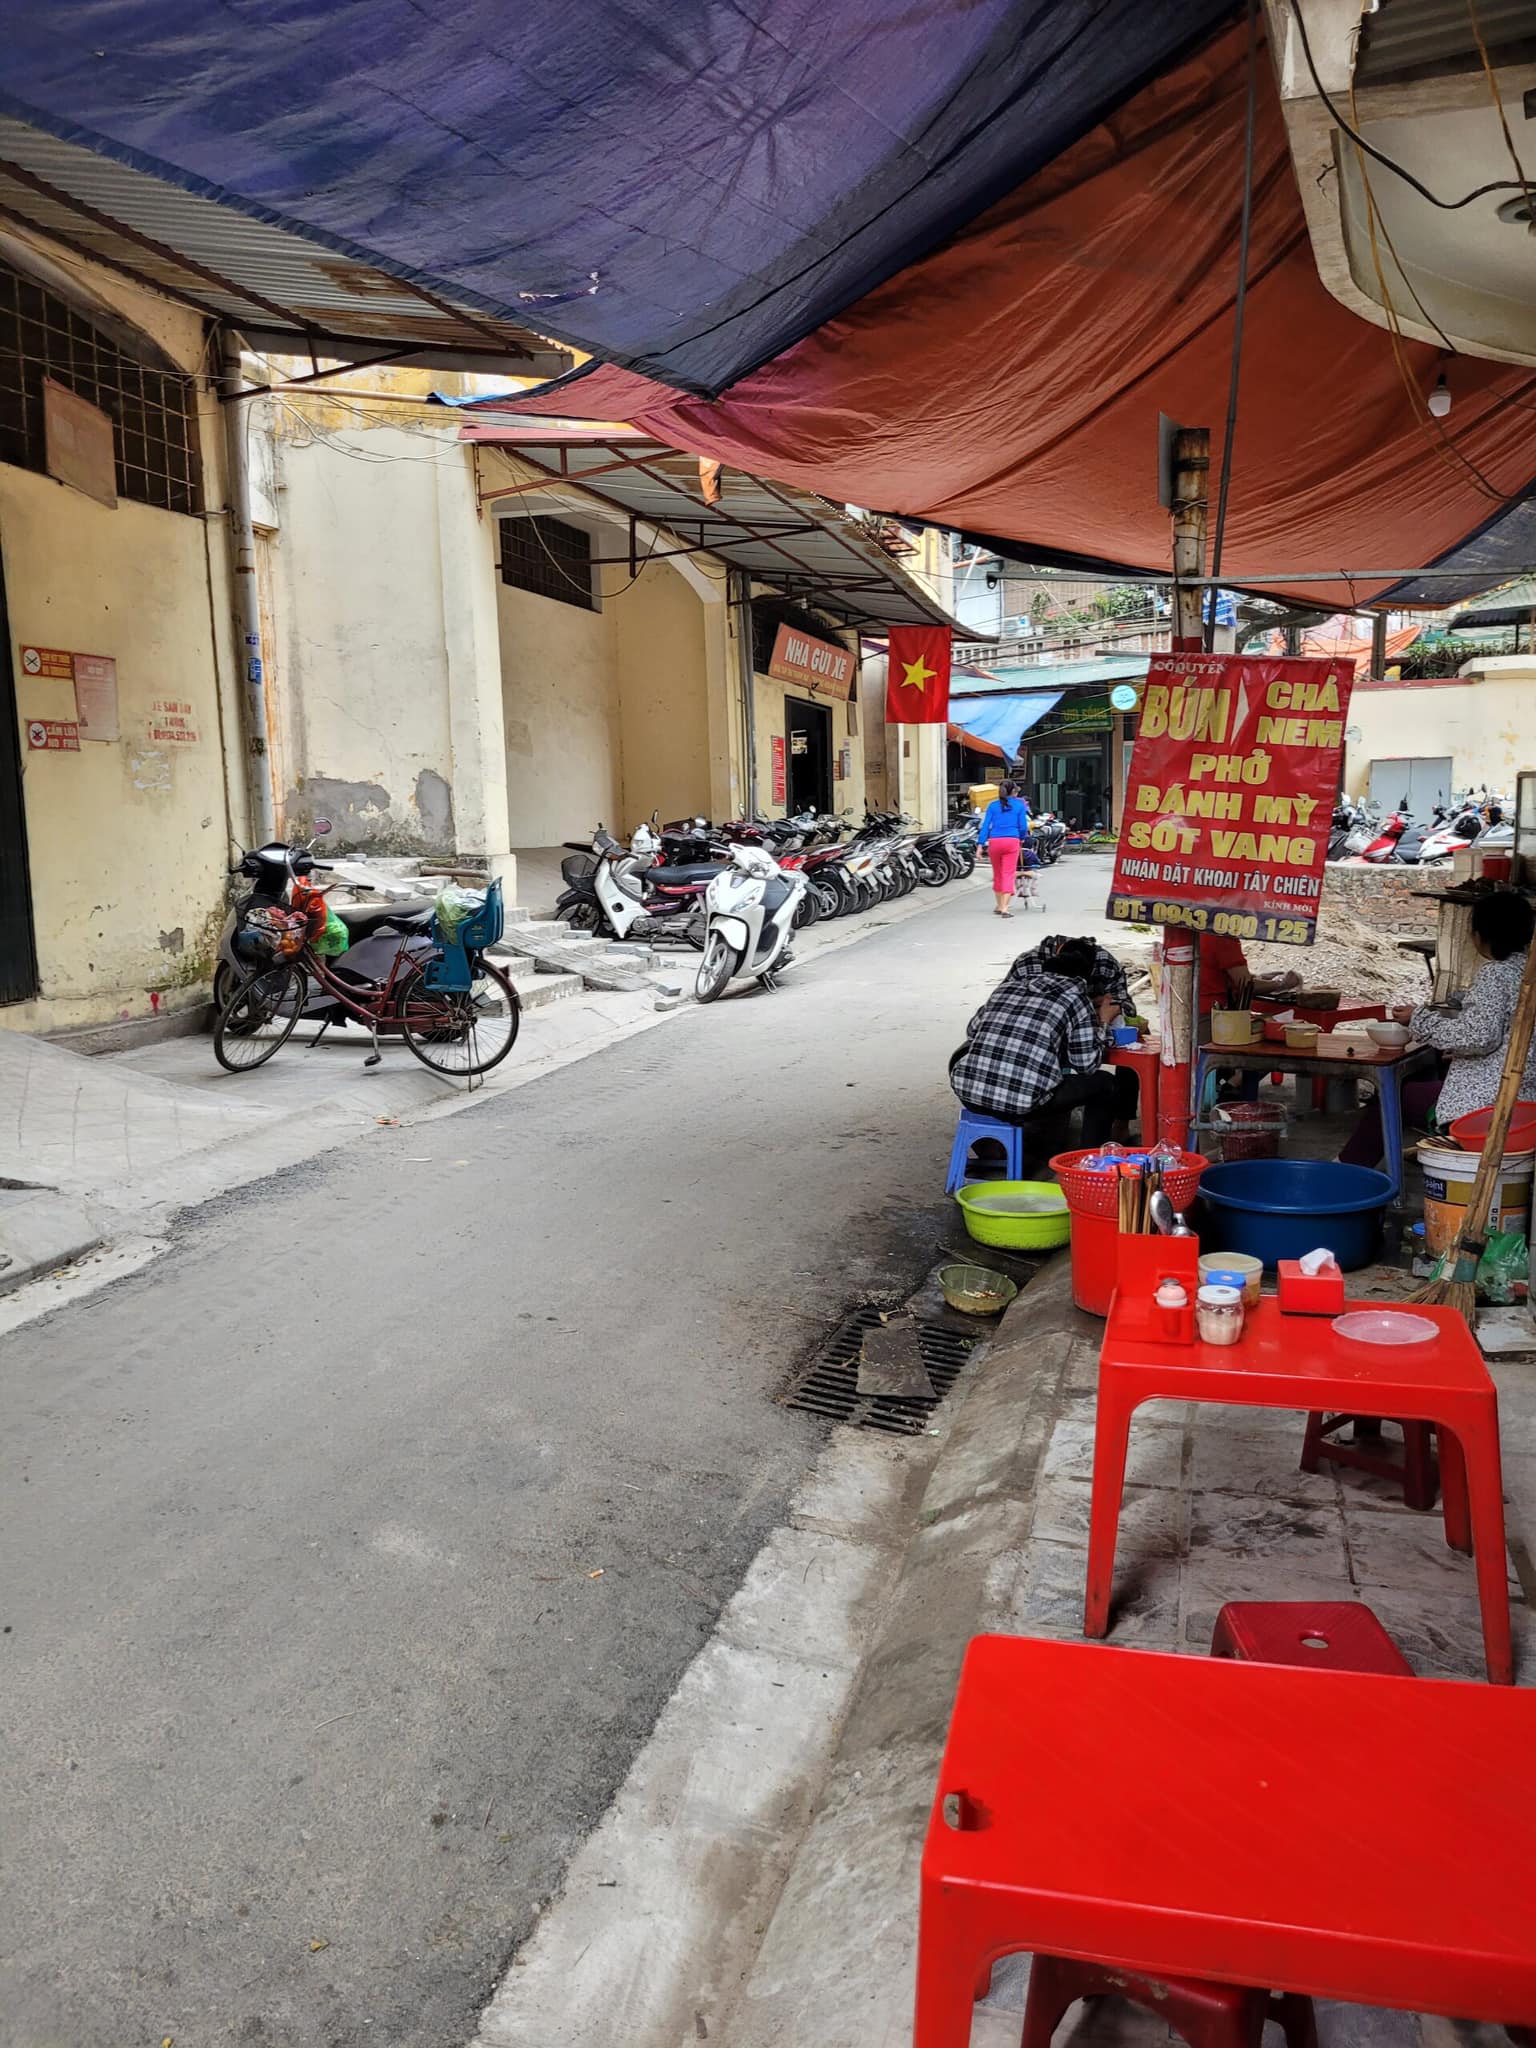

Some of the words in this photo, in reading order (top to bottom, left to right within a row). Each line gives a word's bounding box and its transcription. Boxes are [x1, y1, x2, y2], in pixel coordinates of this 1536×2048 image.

[831, 655, 847, 681] XE
[1139, 675, 1232, 743] BÚN
[1266, 675, 1341, 712] CHẢ
[1255, 716, 1343, 748] NEM
[1189, 749, 1273, 785] PHỞ
[1135, 783, 1243, 821] BÁNH
[1252, 793, 1320, 827] MỲ
[1210, 830, 1317, 866] VANG
[1120, 858, 1160, 882] NHẬN
[1162, 862, 1191, 886] ĐẶT
[1193, 868, 1240, 889] KHOAI
[1243, 870, 1270, 893] TÂY
[1273, 875, 1321, 897] CHIÊN
[1151, 903, 1208, 931] 0943
[1264, 918, 1309, 944] 125
